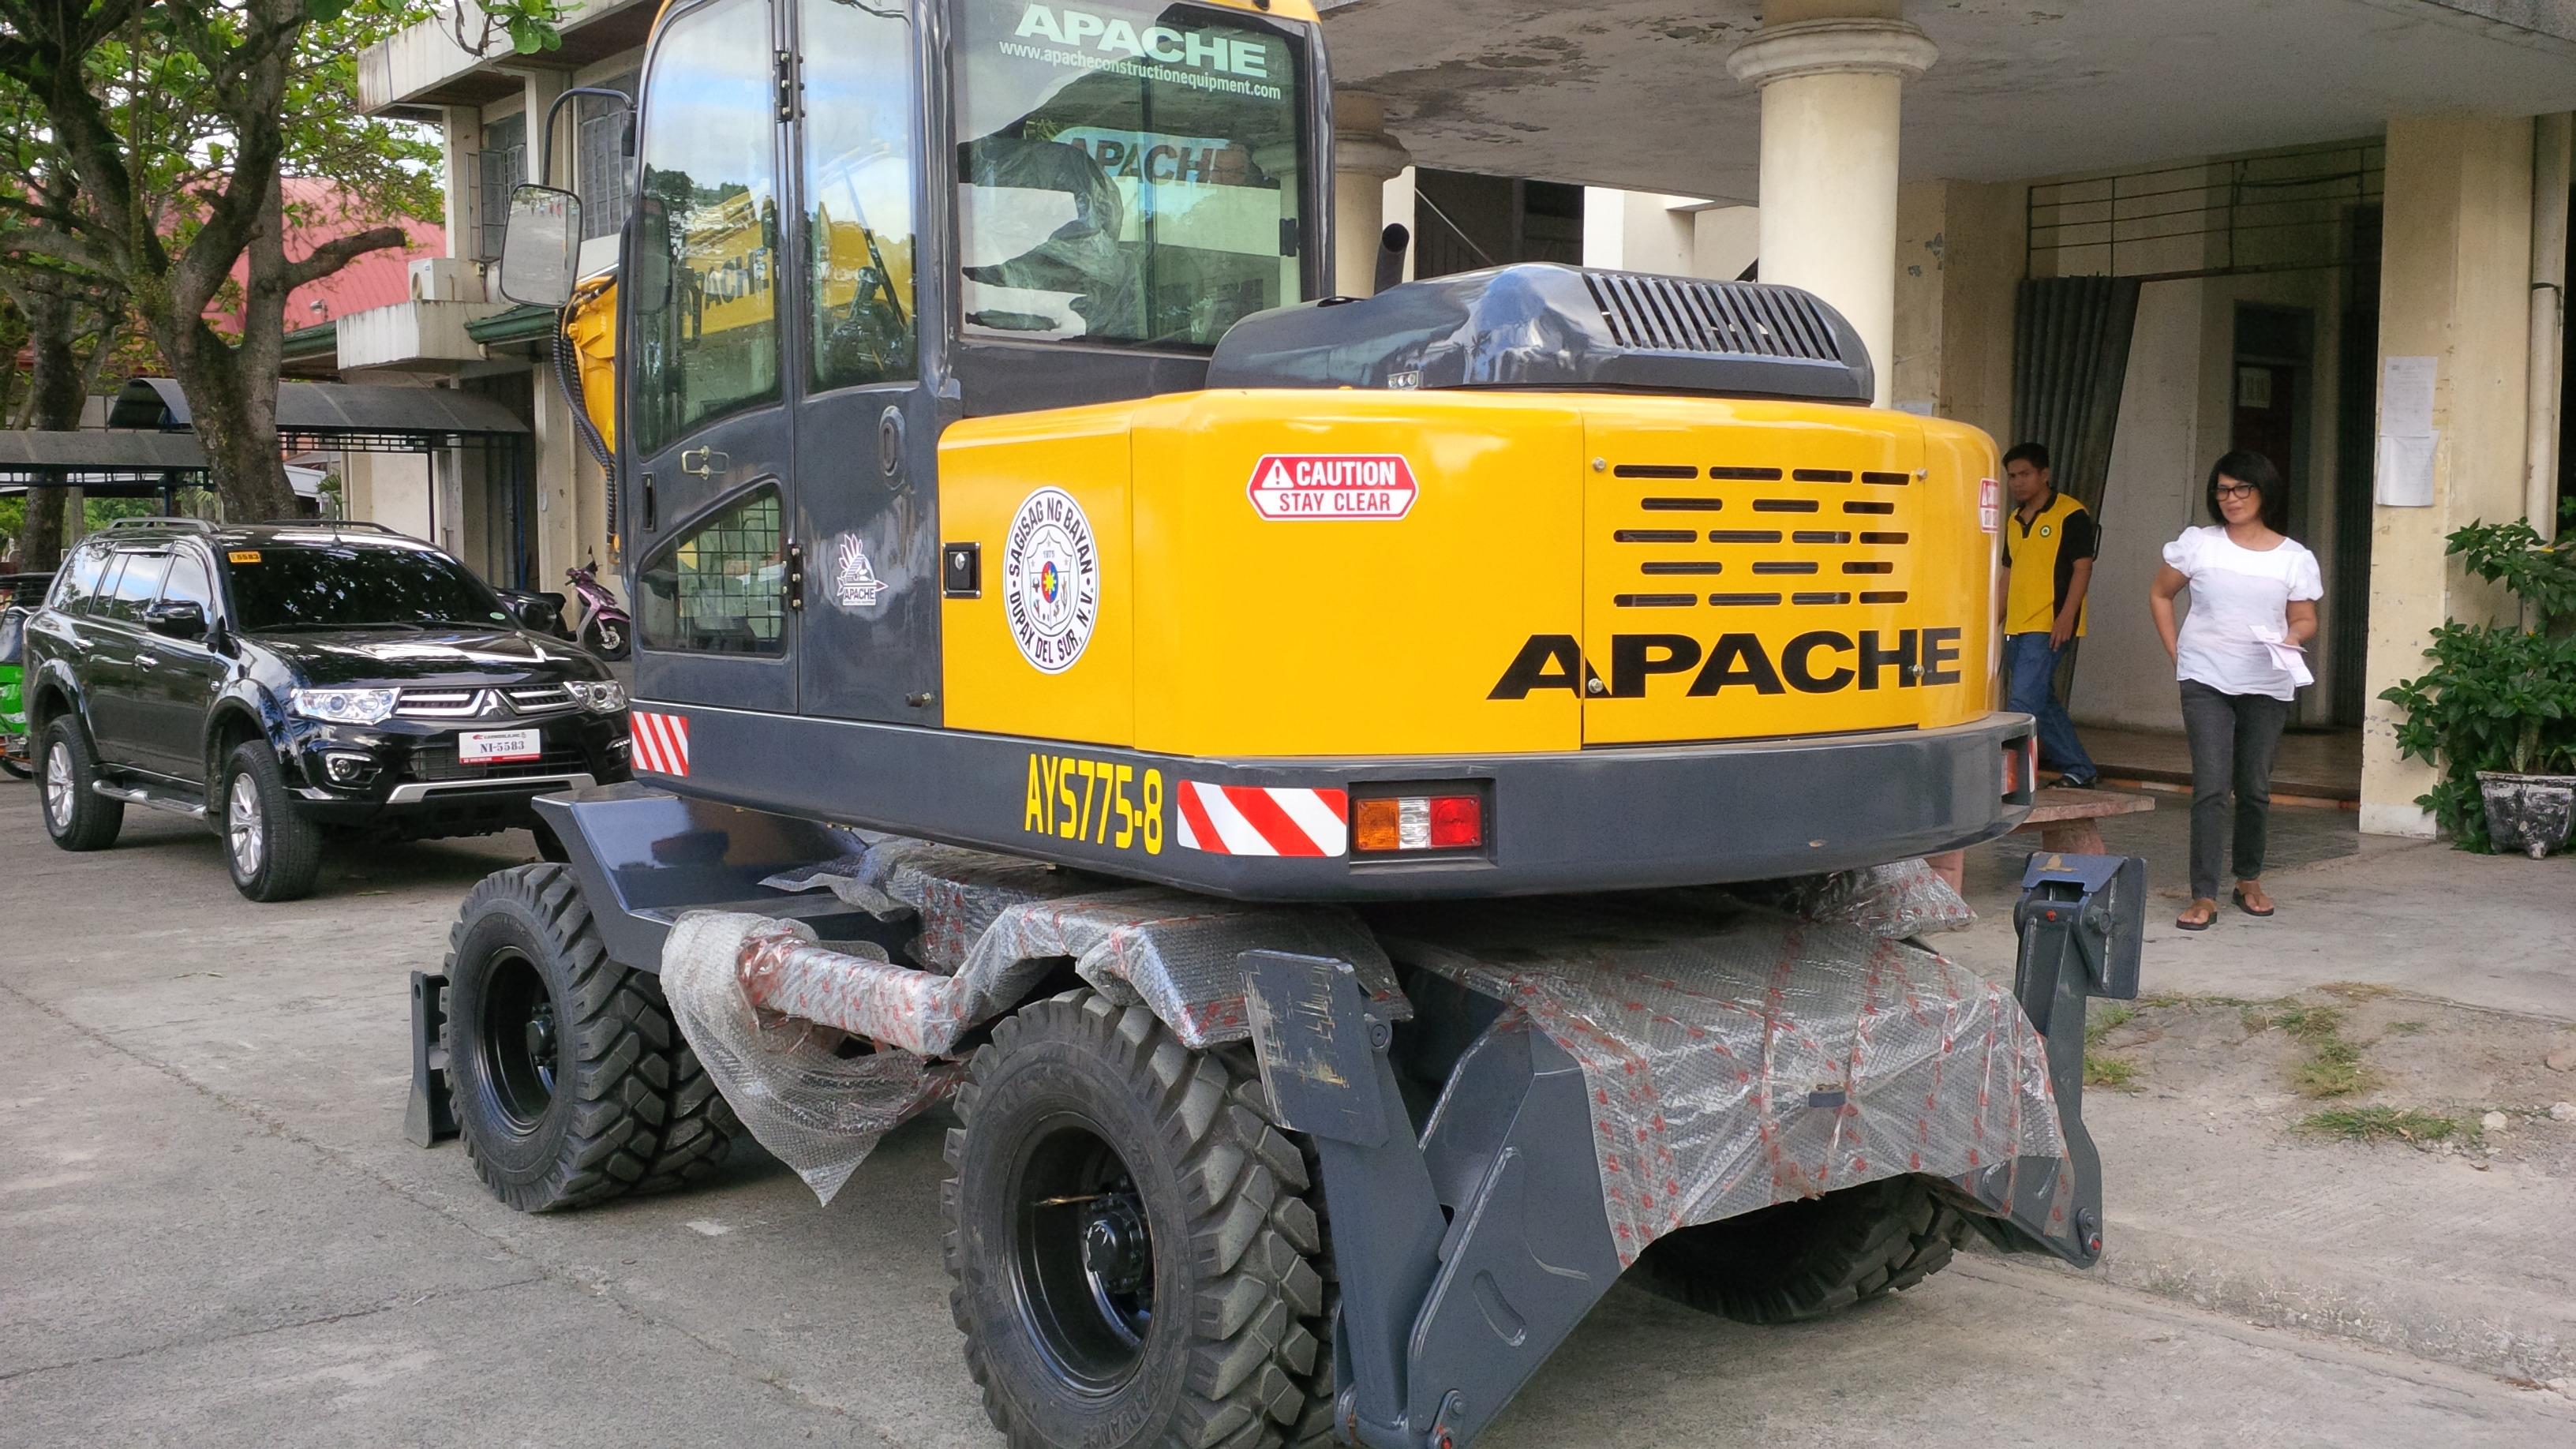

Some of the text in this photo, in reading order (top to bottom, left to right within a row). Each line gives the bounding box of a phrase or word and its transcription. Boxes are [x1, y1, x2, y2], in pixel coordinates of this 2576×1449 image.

[999, 41, 1281, 99] www.apacheconstructionequipment.com
[1014, 3, 1267, 77] APACHE
[1279, 492, 1391, 511] STAY CLEAR
[1296, 461, 1396, 486] CAUTION
[1009, 497, 1093, 577] SAGISAG NG BAYAN
[844, 588, 874, 600] APACHE
[1009, 591, 1035, 650] DUPAX
[1035, 637, 1054, 663] DEL
[1486, 627, 1961, 700] APACHE
[480, 740, 525, 754] NI-5583
[1024, 754, 1163, 855] AYS775-8
